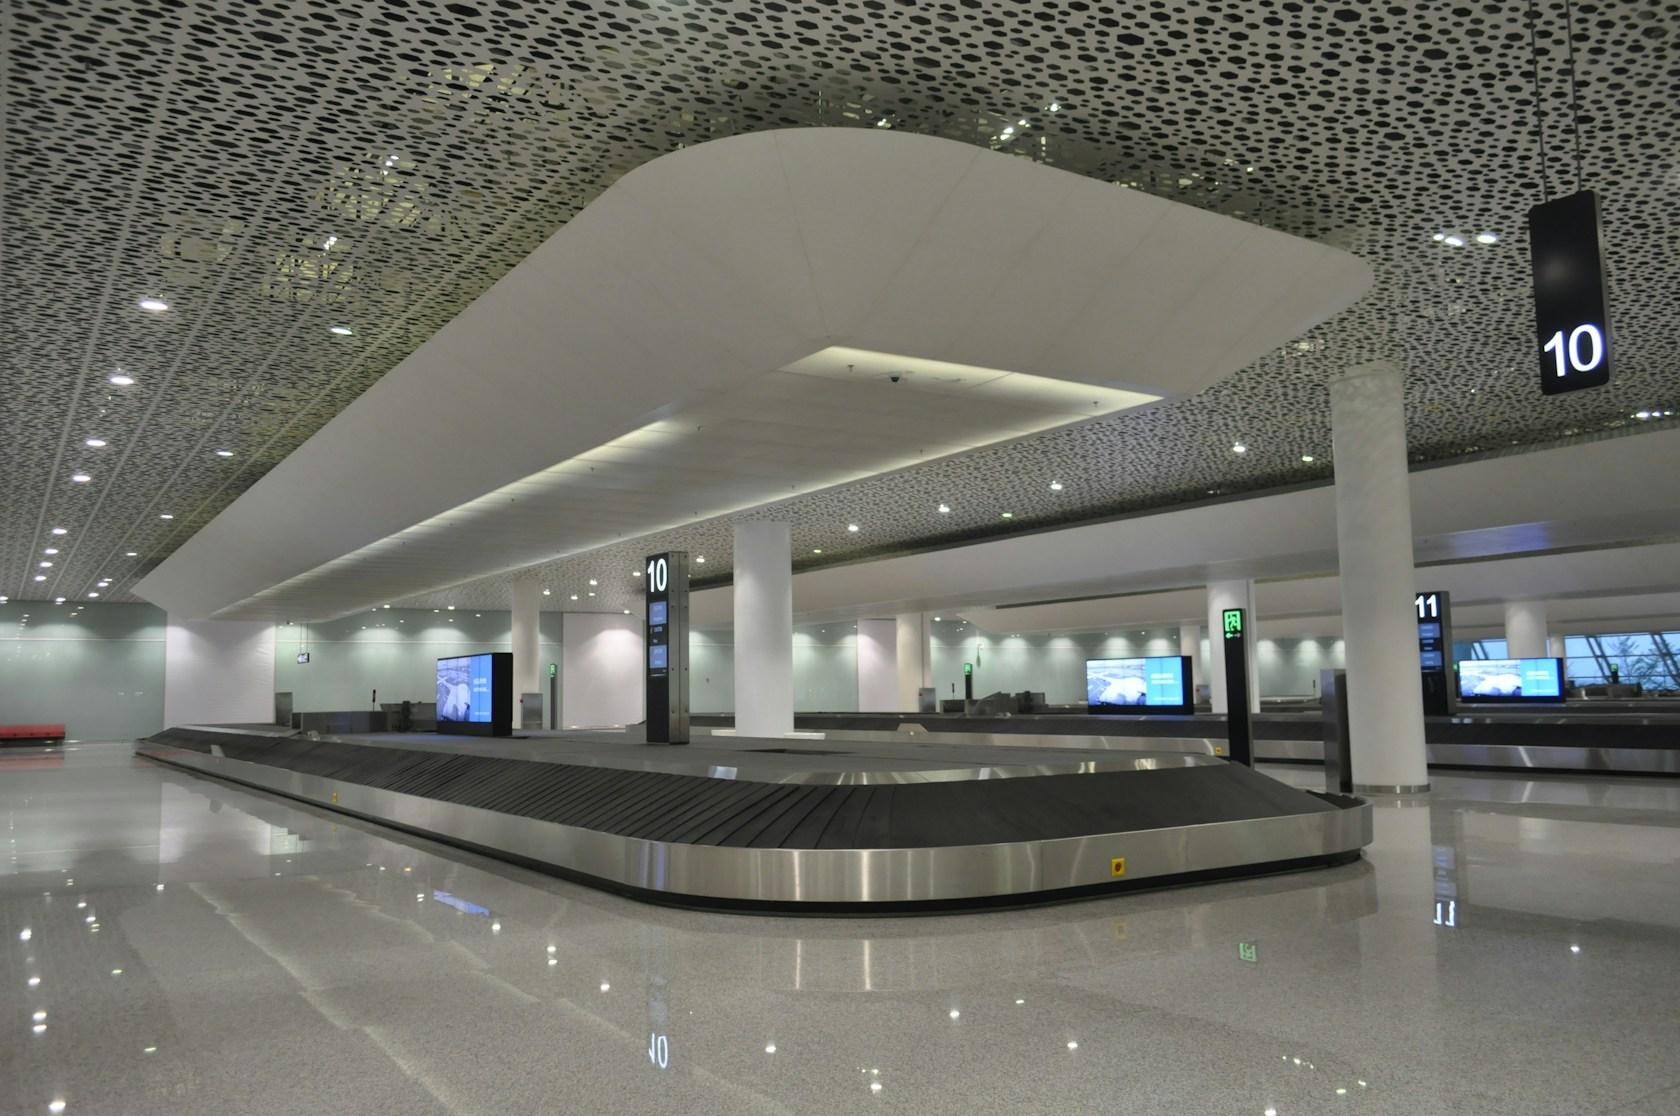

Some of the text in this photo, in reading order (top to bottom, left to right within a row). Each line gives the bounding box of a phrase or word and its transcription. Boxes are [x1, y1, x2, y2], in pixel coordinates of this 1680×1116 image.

[1543, 324, 1603, 377] 10
[647, 558, 668, 592] 10
[1414, 594, 1438, 618] 11
